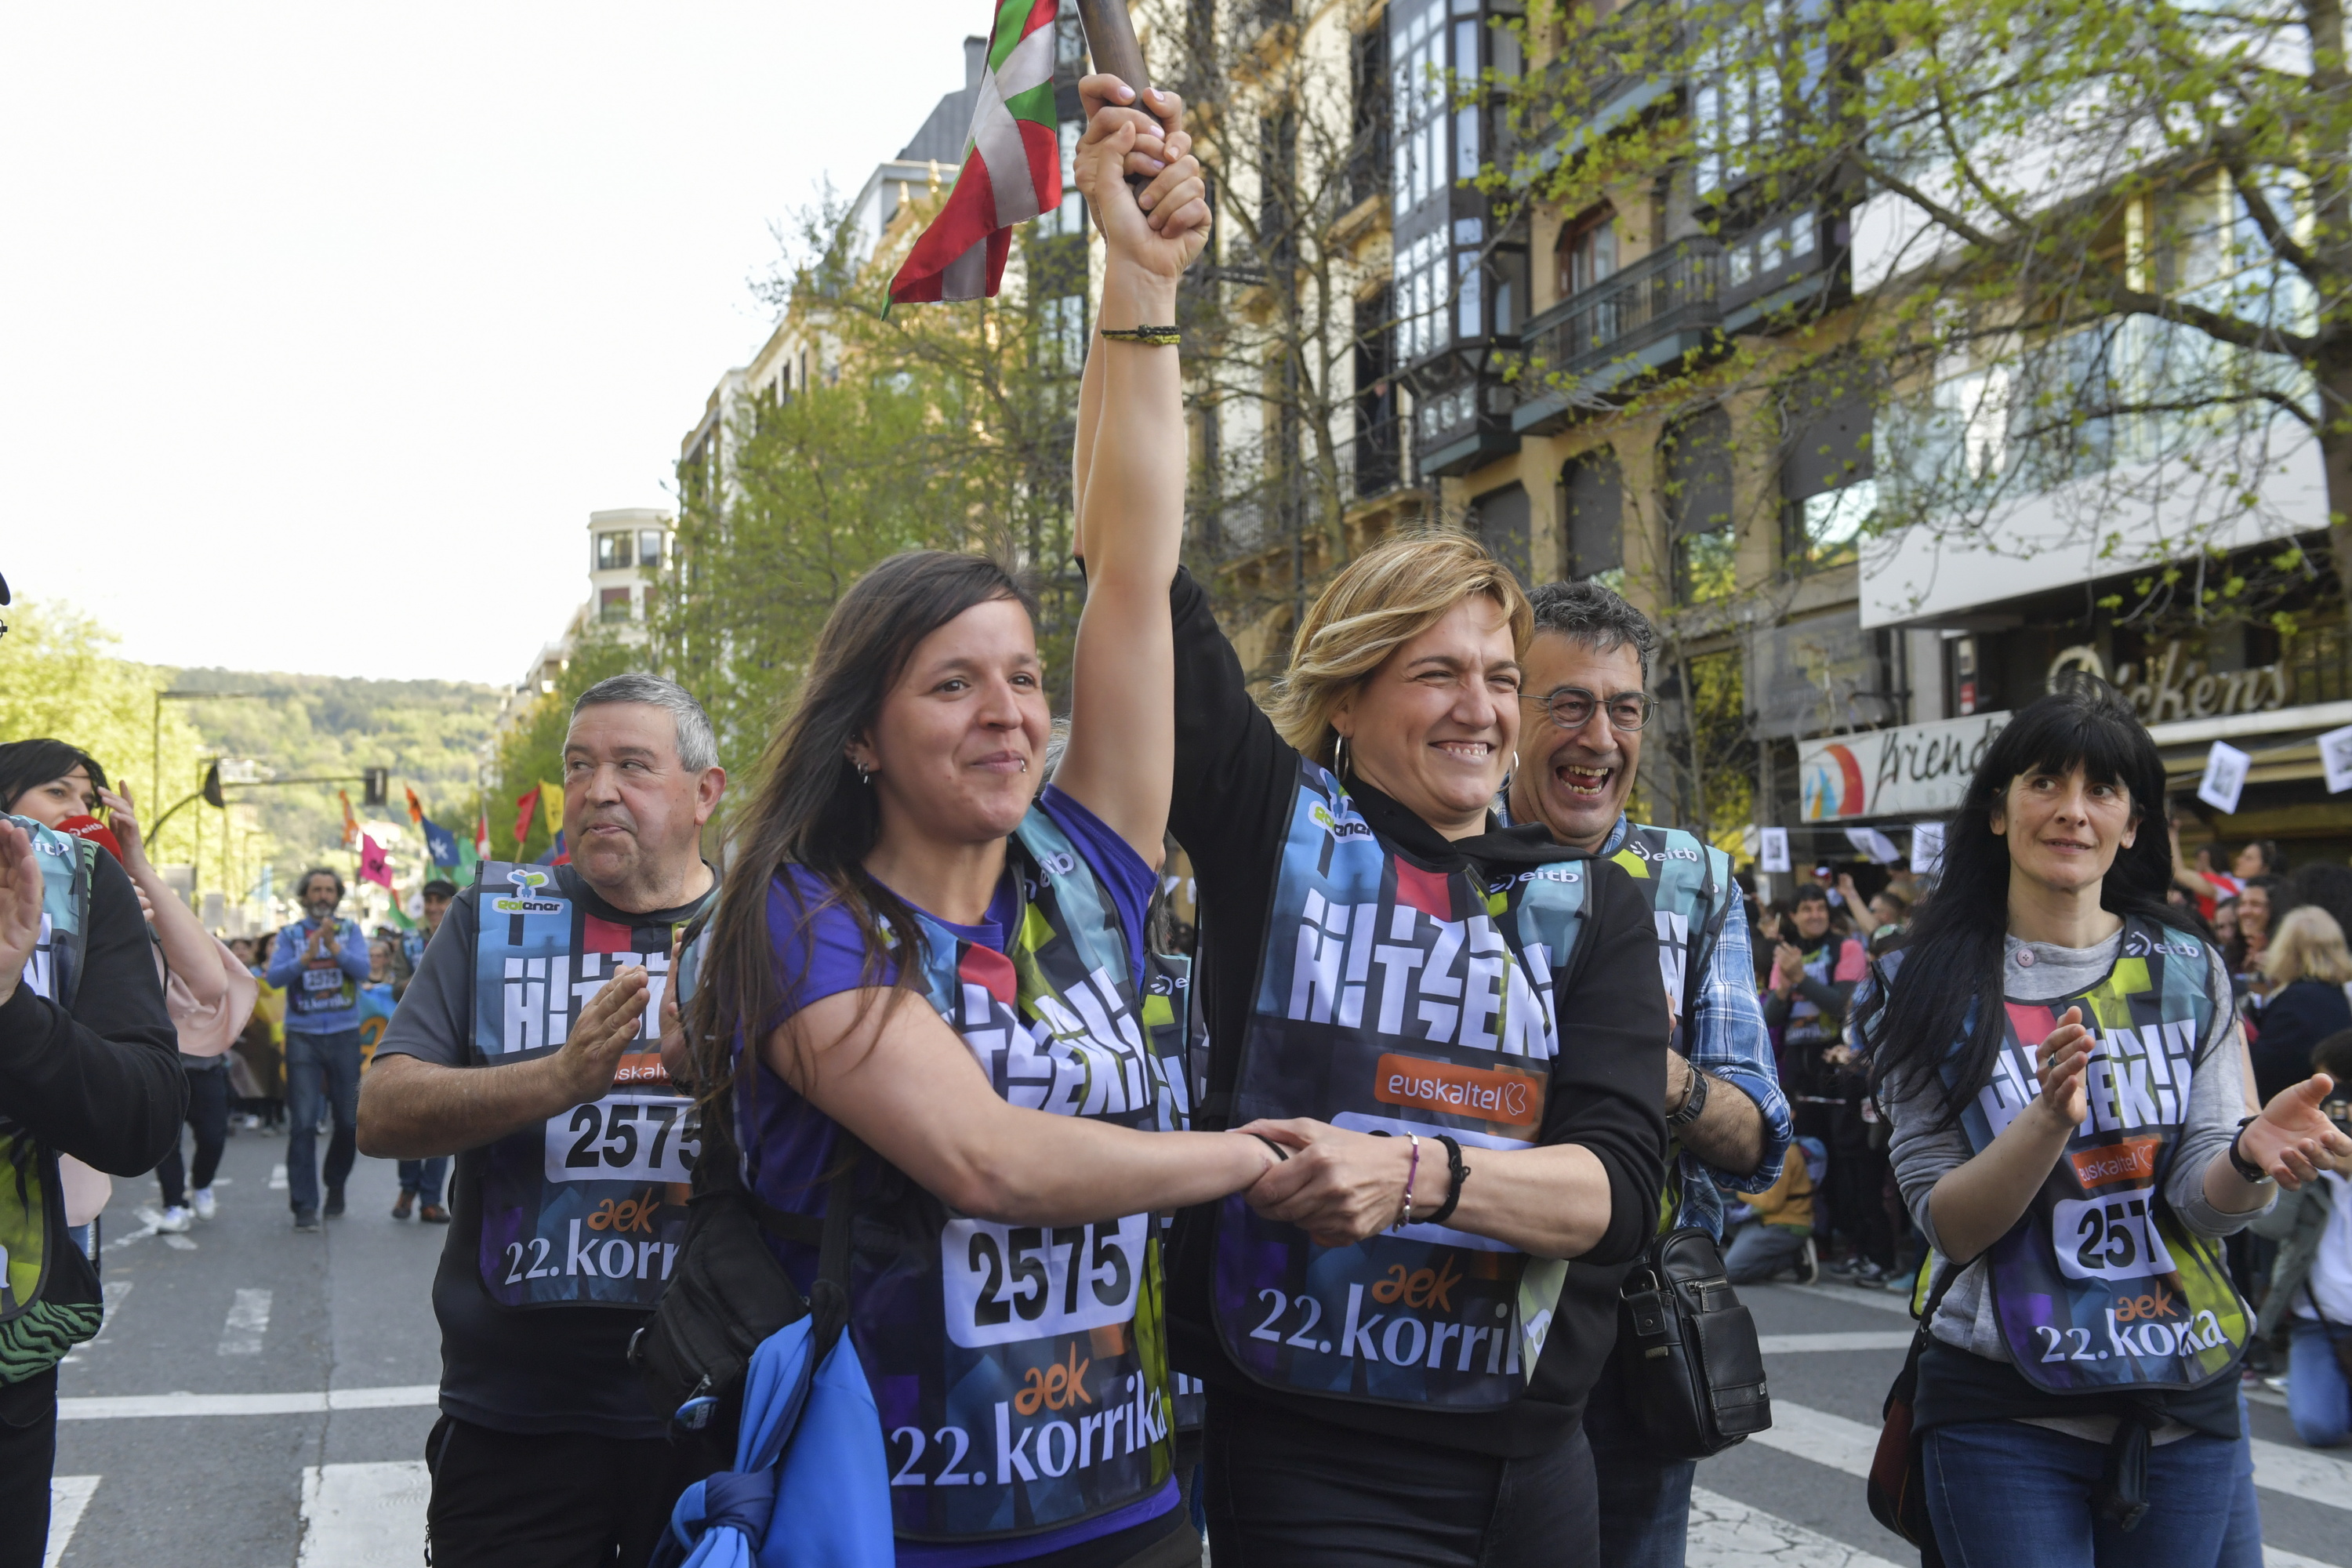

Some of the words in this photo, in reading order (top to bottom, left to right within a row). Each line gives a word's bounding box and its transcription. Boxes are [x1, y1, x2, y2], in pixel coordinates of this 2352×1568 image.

[30, 839, 69, 856] itb
[81, 822, 103, 834] eitb
[1653, 847, 1697, 862] eitb
[1518, 868, 1579, 884] eitb
[497, 899, 561, 912] goiener
[2153, 942, 2199, 957] eitb
[1388, 1073, 1501, 1112] euskaltel
[587, 1186, 660, 1233] aek
[2076, 1199, 2158, 1269] 257
[968, 1218, 1132, 1327] 2575
[1371, 1254, 1464, 1312] aek
[2114, 1279, 2178, 1322] aek
[1014, 1341, 1092, 1415] aek
